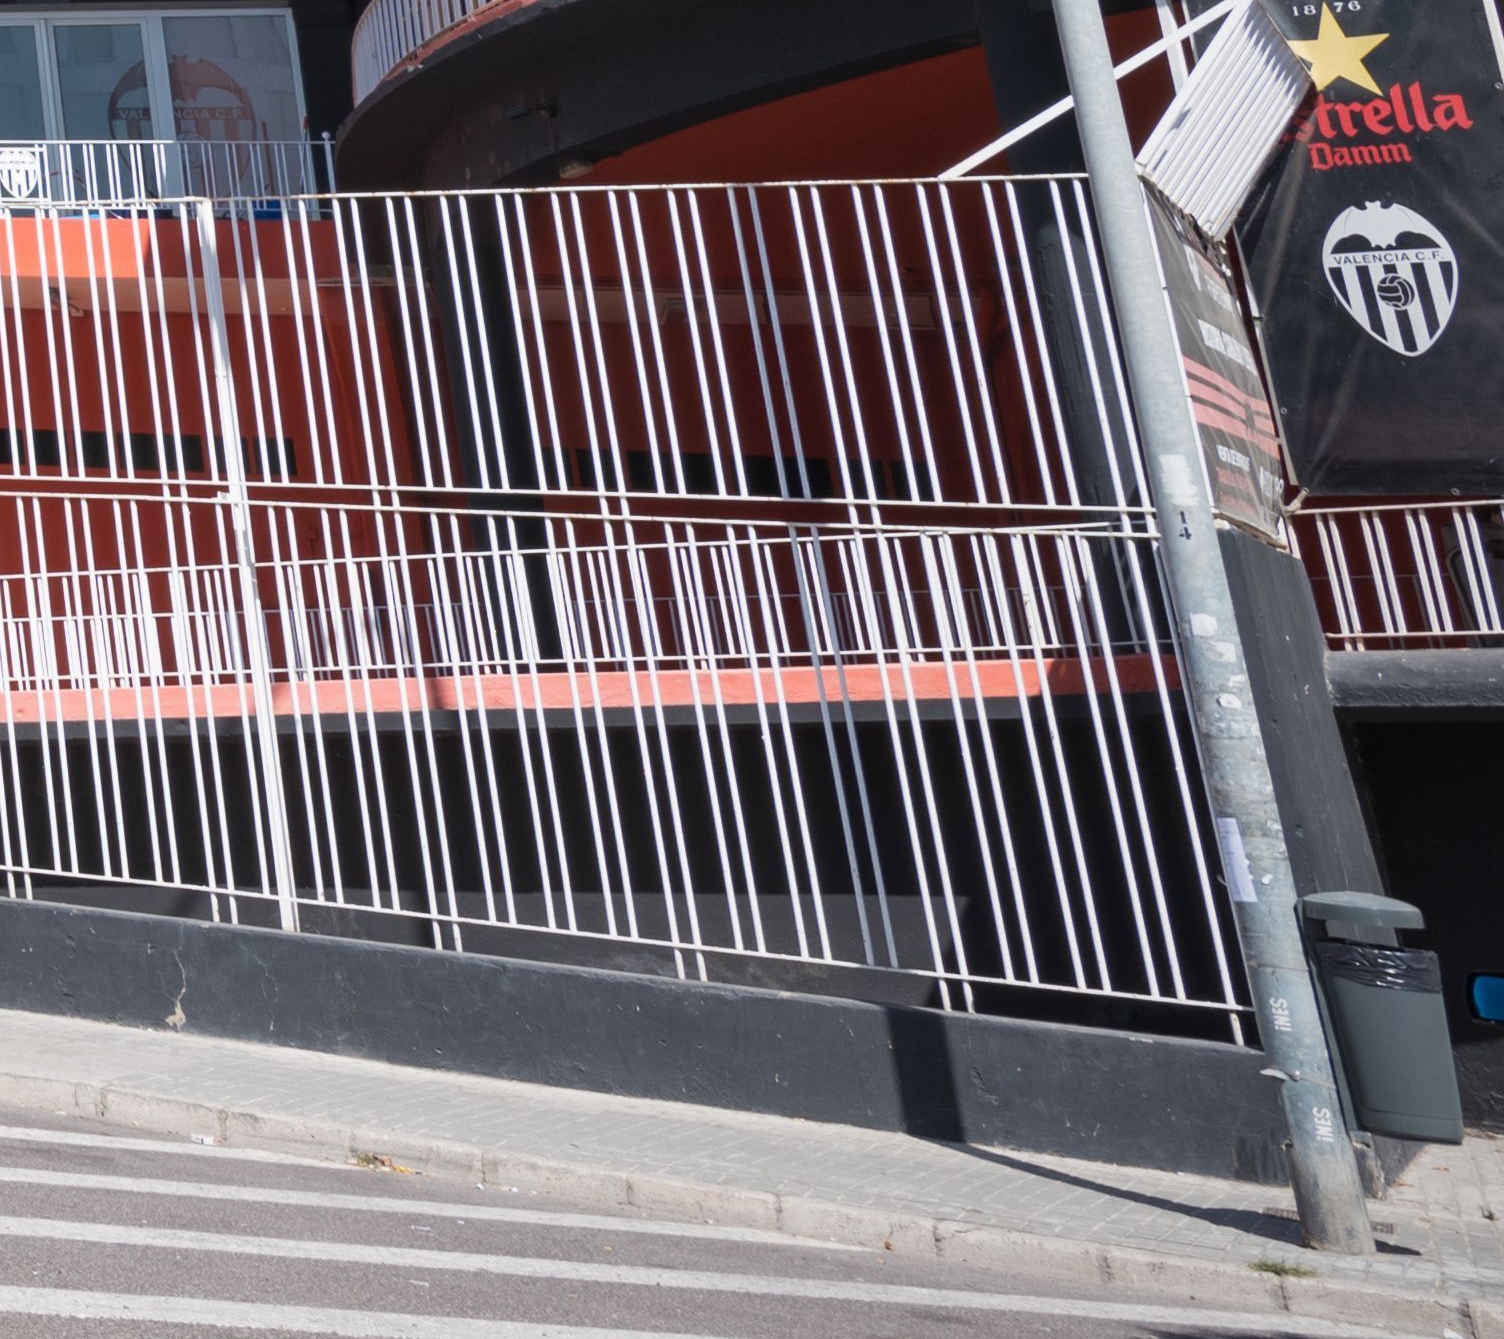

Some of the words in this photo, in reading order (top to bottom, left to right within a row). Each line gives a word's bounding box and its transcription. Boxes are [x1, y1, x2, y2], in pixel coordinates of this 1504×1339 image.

[118, 108, 210, 119] VALNCIA
[1293, 80, 1473, 143] trella
[1308, 141, 1412, 171] Damm
[1333, 252, 1410, 265] VALENCIA
[1415, 250, 1444, 261] C.F.
